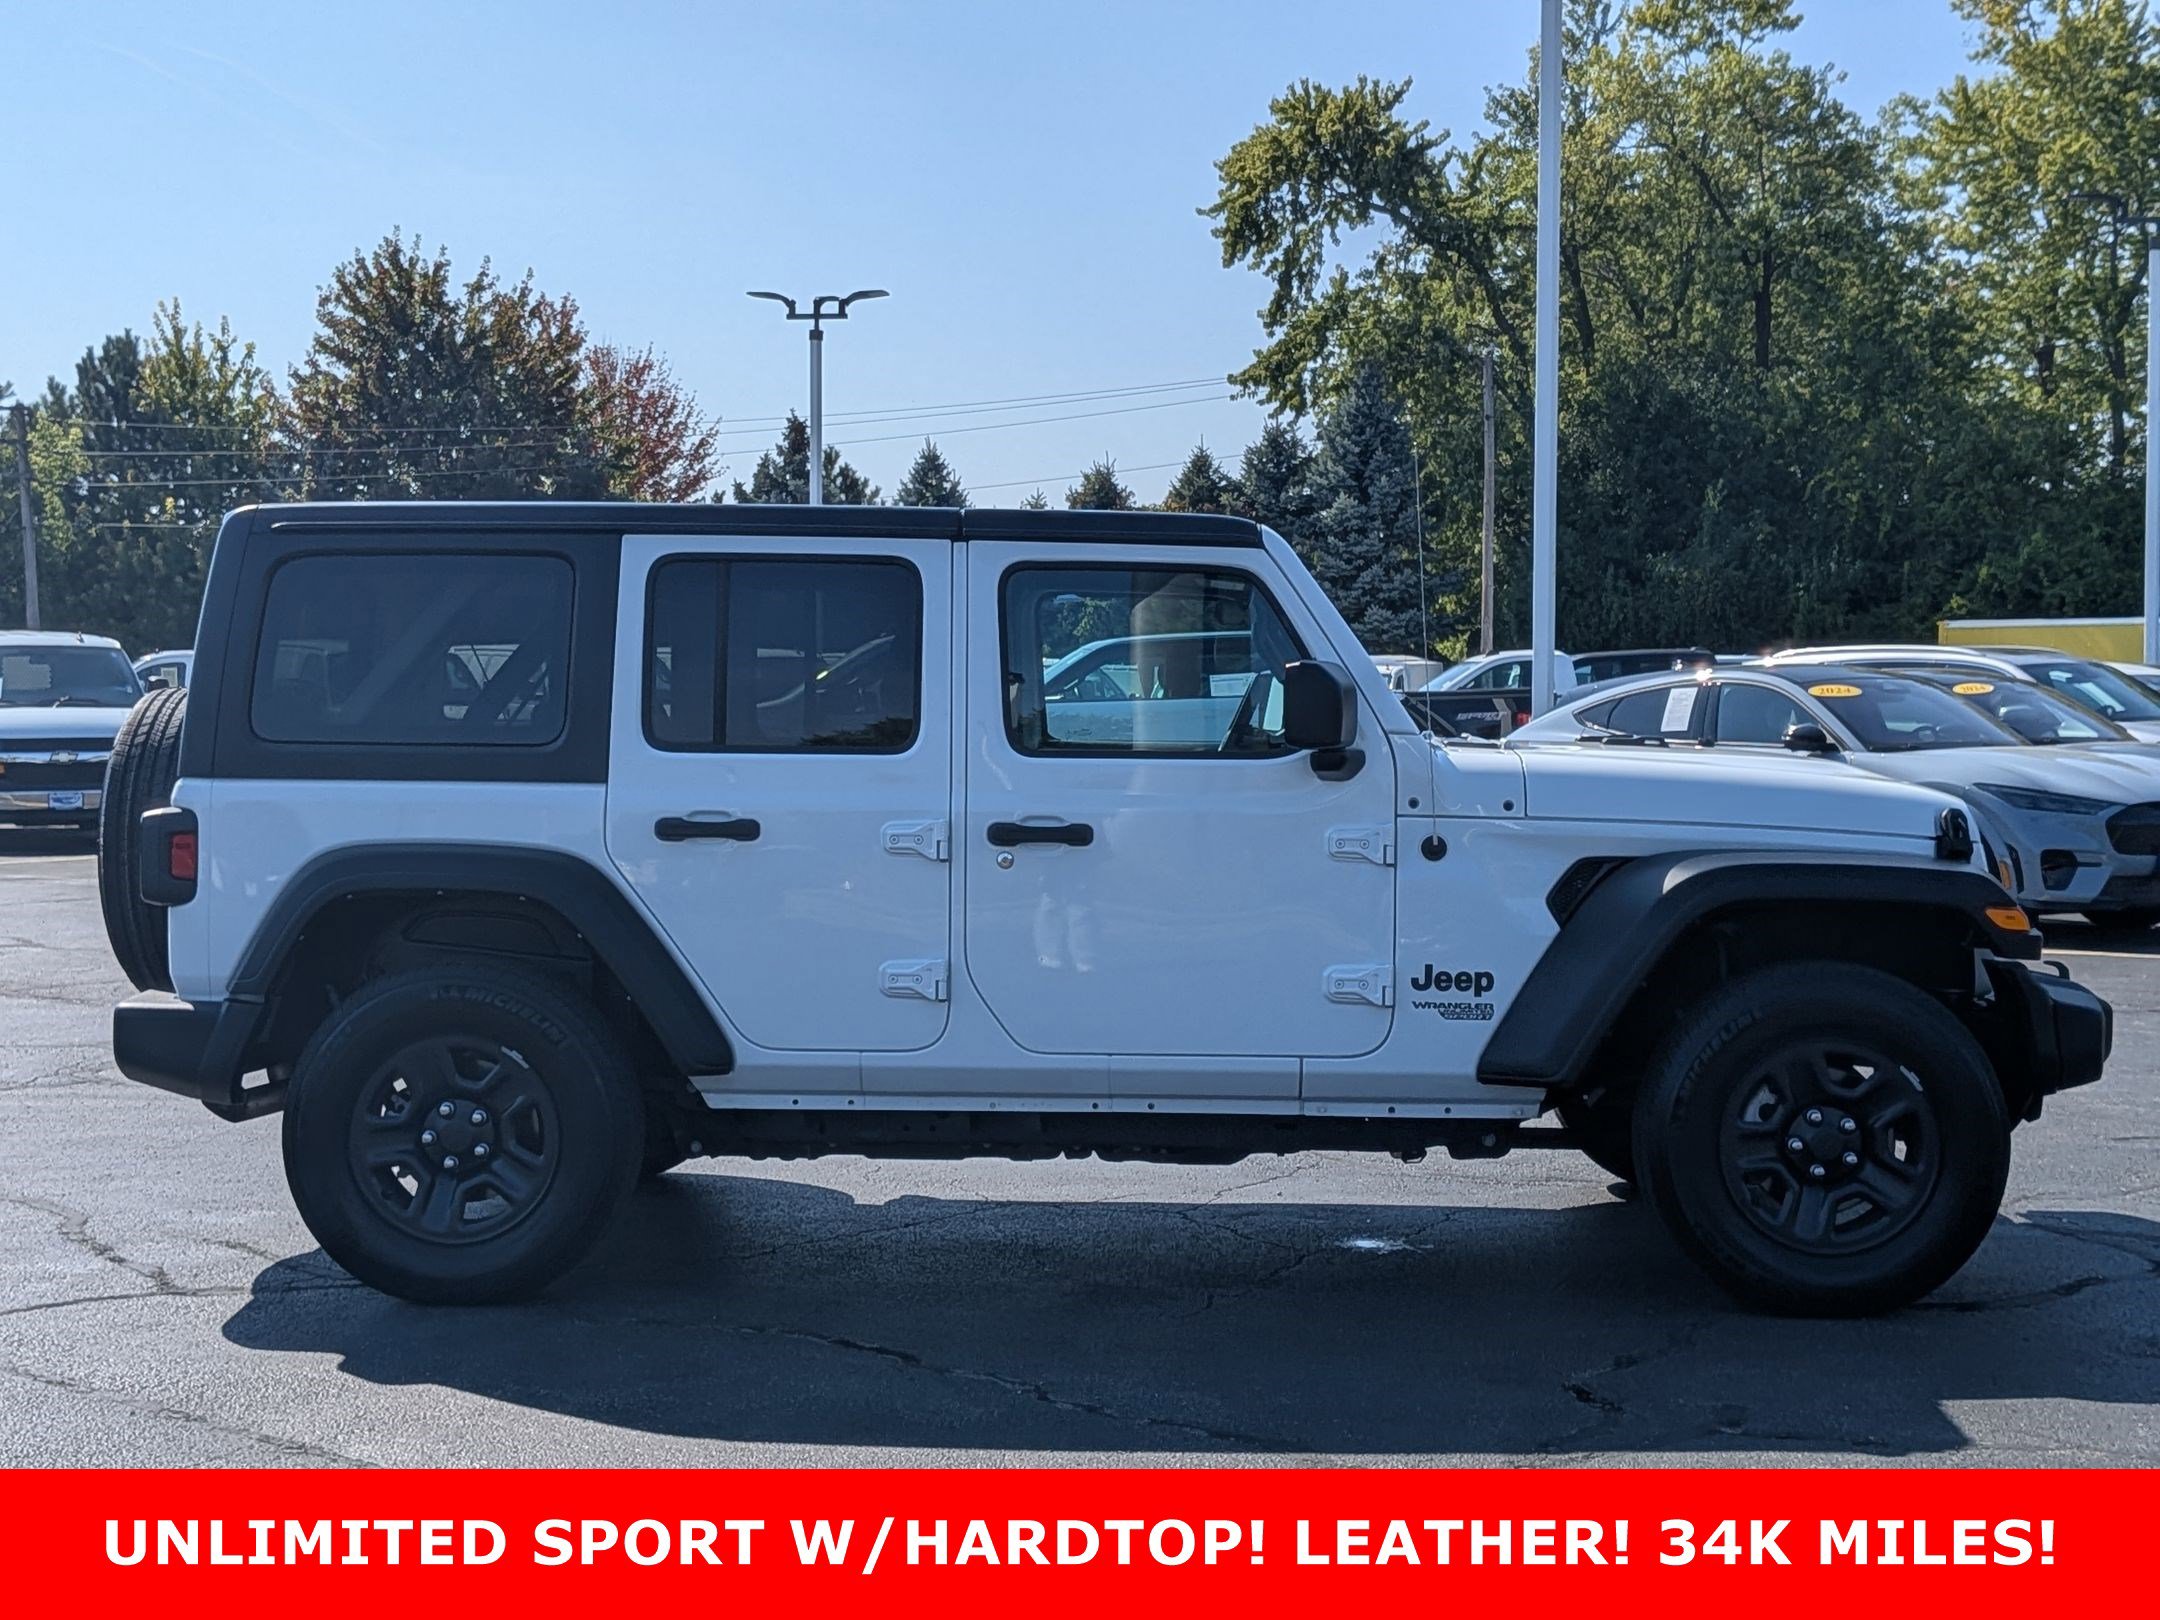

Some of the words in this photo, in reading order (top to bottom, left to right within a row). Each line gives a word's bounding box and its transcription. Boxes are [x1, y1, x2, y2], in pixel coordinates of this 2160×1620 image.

[1818, 687, 1851, 695] 2024
[1411, 963, 1495, 997] Jeep
[1411, 1000, 1494, 1010] WRANGLER
